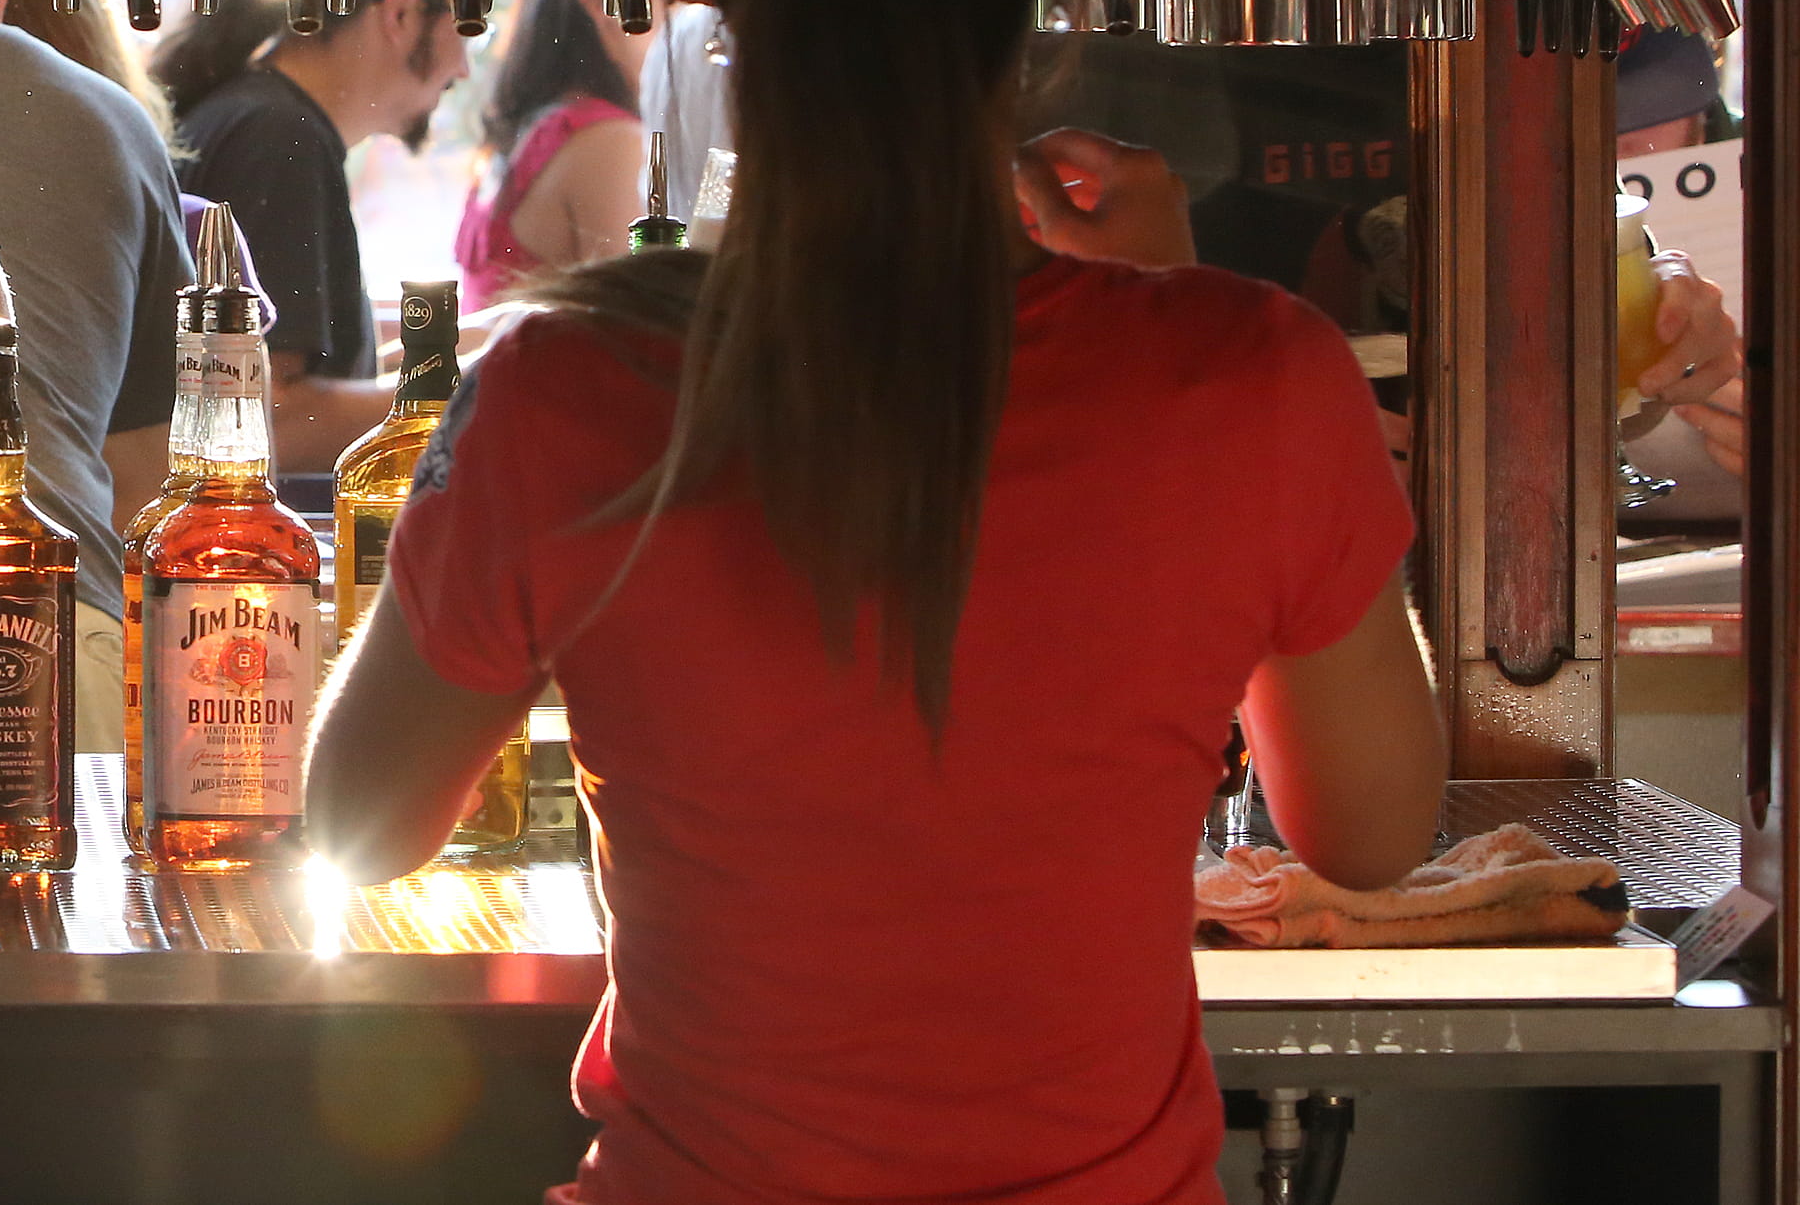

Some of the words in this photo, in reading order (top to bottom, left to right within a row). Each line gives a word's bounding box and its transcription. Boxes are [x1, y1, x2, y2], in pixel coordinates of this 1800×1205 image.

[403, 302, 429, 320] 1829
[180, 607, 227, 650] JIM
[234, 598, 301, 651] BEAM
[188, 699, 294, 725] BOURBON
[203, 726, 241, 736] KENTUCKY
[244, 726, 279, 736] STRAIGHT
[206, 736, 241, 745] BOURBON
[244, 736, 276, 745] WHISKEY
[190, 779, 215, 794] JAMES
[222, 779, 242, 787] BEAM
